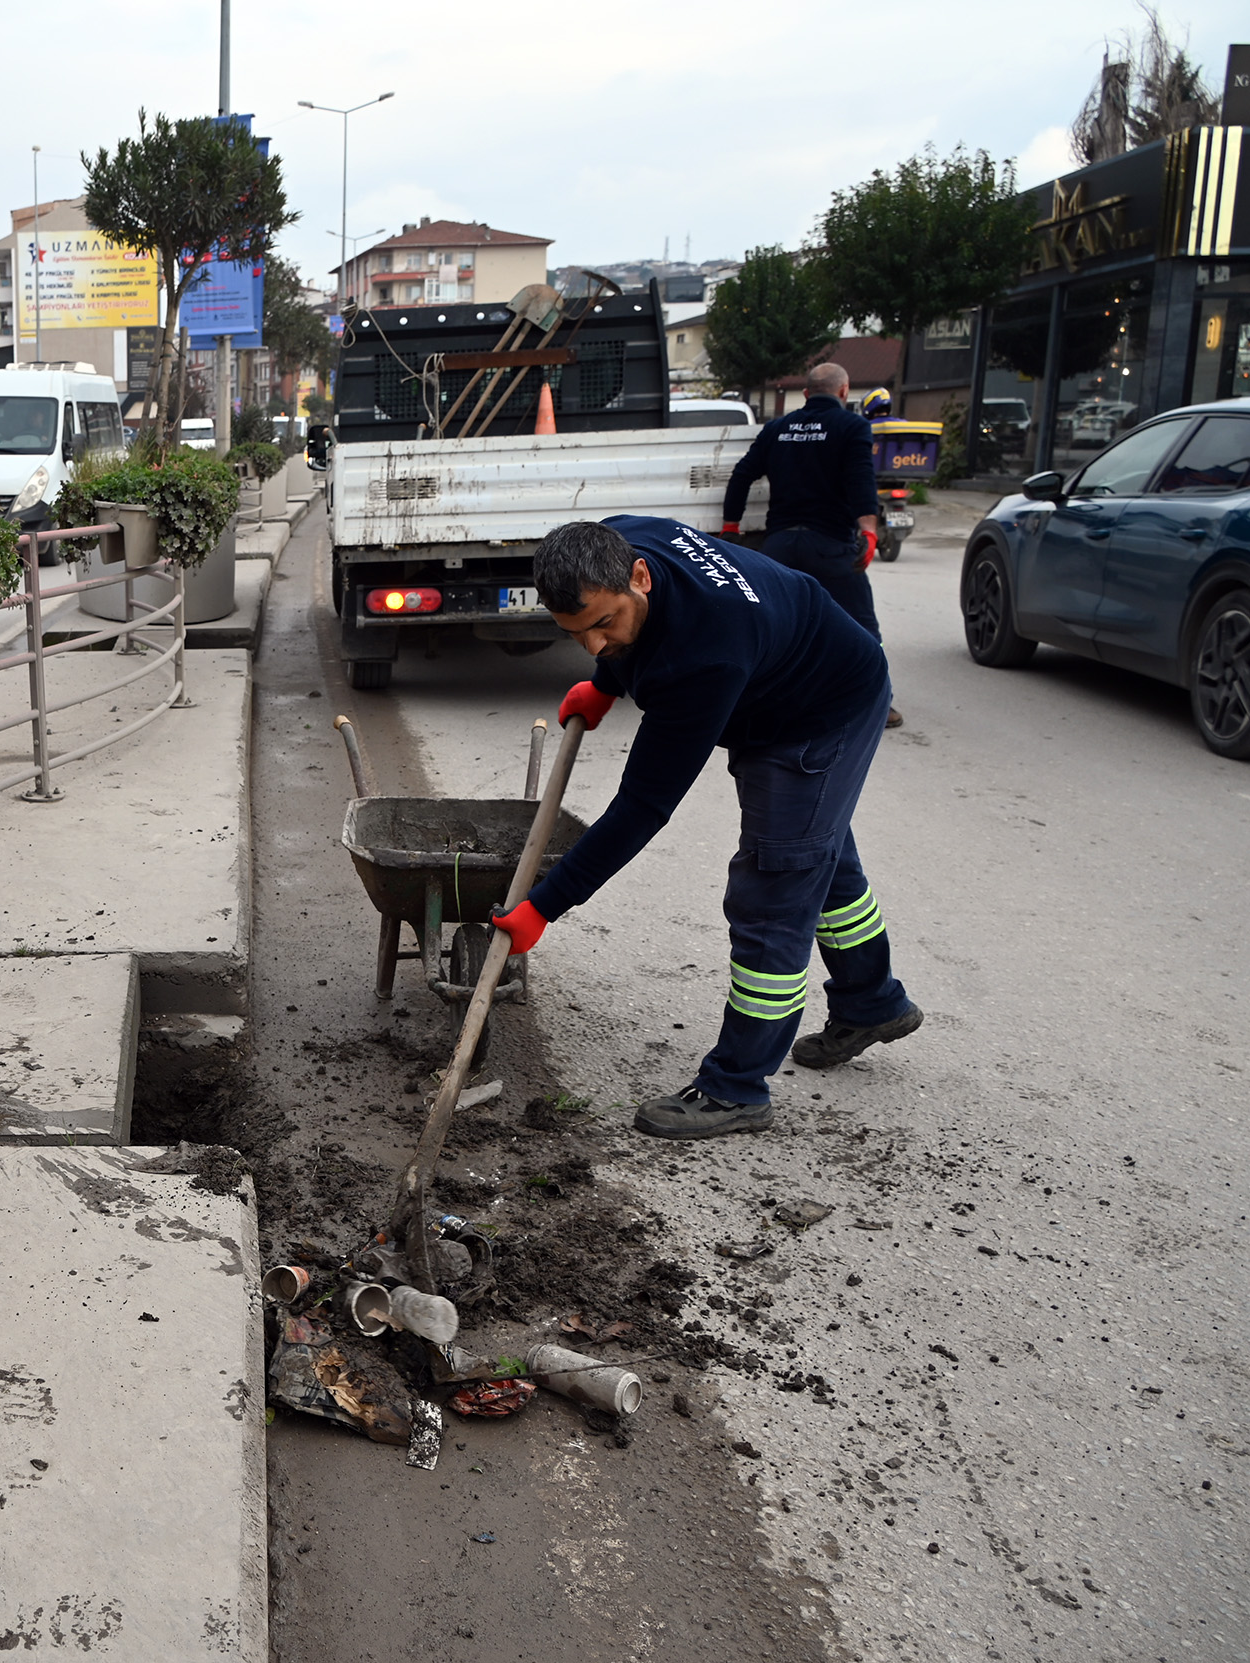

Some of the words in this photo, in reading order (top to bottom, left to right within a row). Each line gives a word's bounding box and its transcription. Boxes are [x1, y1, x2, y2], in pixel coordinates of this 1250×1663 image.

[927, 319, 971, 338] ASLAN
[789, 423, 822, 431] YALOVA
[777, 431, 828, 442] BELEDİYESİ
[892, 453, 928, 469] getir
[670, 536, 730, 587] YALOVA
[675, 526, 760, 604] BELEDİYESİ
[508, 589, 526, 606] 41
